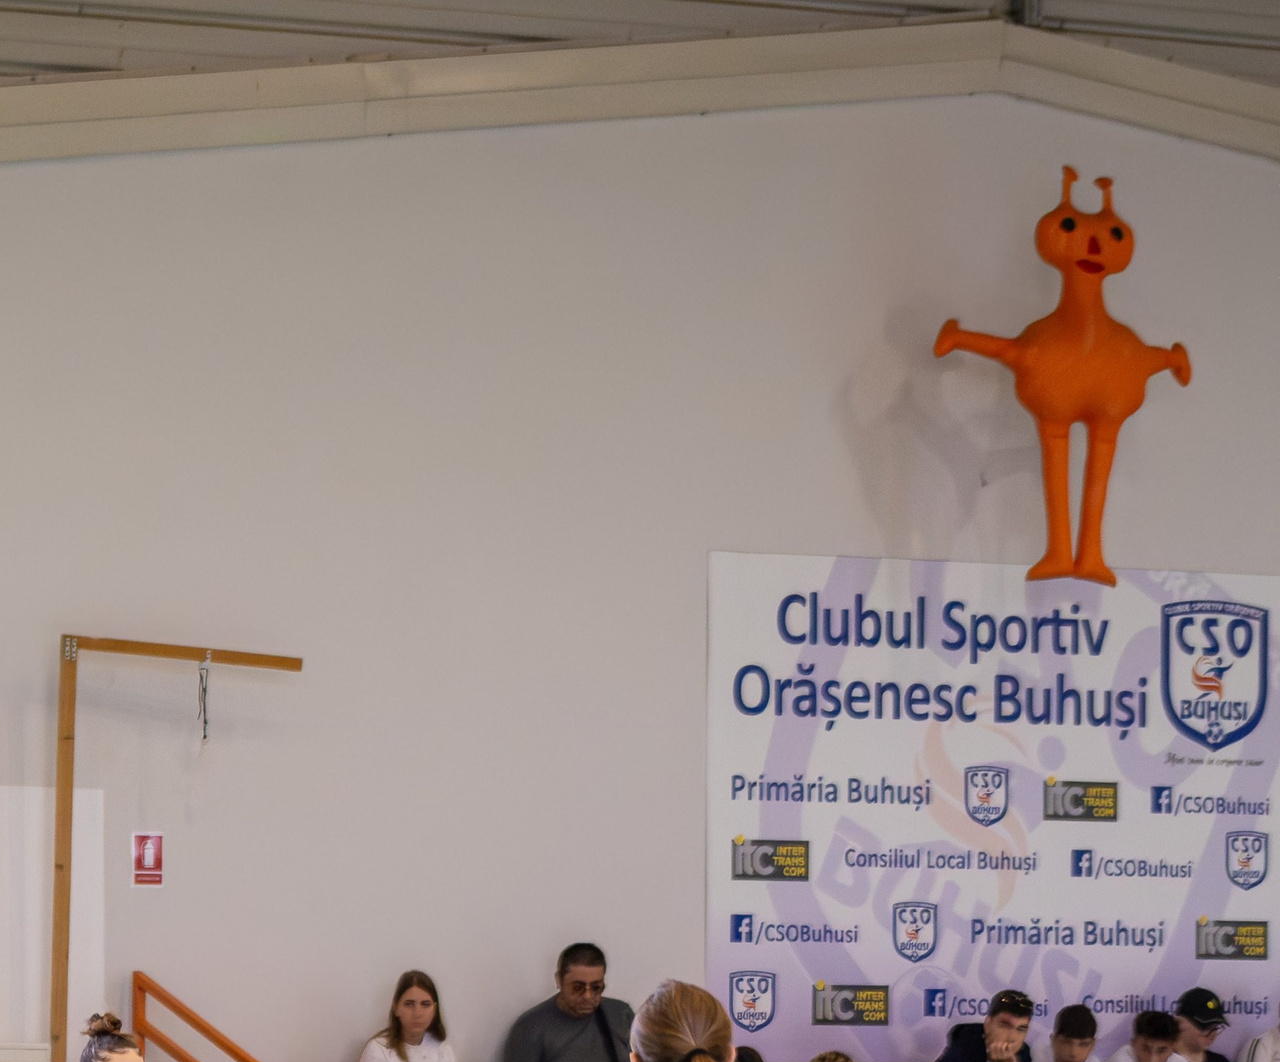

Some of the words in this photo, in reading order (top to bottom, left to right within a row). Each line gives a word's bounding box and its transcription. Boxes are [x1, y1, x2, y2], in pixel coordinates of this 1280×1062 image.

[776, 592, 926, 649] Clubul
[941, 600, 1109, 665] Sportiv
[1175, 616, 1254, 658] CSO
[732, 663, 978, 731] Orășenesc
[993, 673, 1149, 740] Buhuși
[970, 772, 1003, 789] CSO
[731, 774, 839, 804] Primăria
[847, 777, 932, 811] Buhuși
[1086, 787, 1115, 797] INTER
[1083, 797, 1115, 807] TRANS
[1174, 796, 1271, 816] /CSOBuhusi
[776, 846, 806, 856] INTER
[1231, 837, 1261, 853] CSO
[773, 856, 806, 866] TRANS
[844, 848, 921, 868] Consiliul
[927, 850, 971, 869] Local
[977, 851, 1037, 874] Buhuși
[1095, 858, 1193, 879] /CSOBuhusi
[783, 867, 807, 877] COM
[898, 908, 931, 925] CSO
[755, 922, 858, 945] /CSOBuhusi
[970, 918, 1075, 946] Primăria
[1084, 920, 1165, 952] Buhuși
[1237, 926, 1265, 936] INTER
[1234, 936, 1265, 946] TRANS
[735, 977, 770, 995] CSO
[857, 991, 885, 1001] INTER
[853, 1001, 885, 1011] TRANS
[1220, 996, 1269, 1019] uhuși
